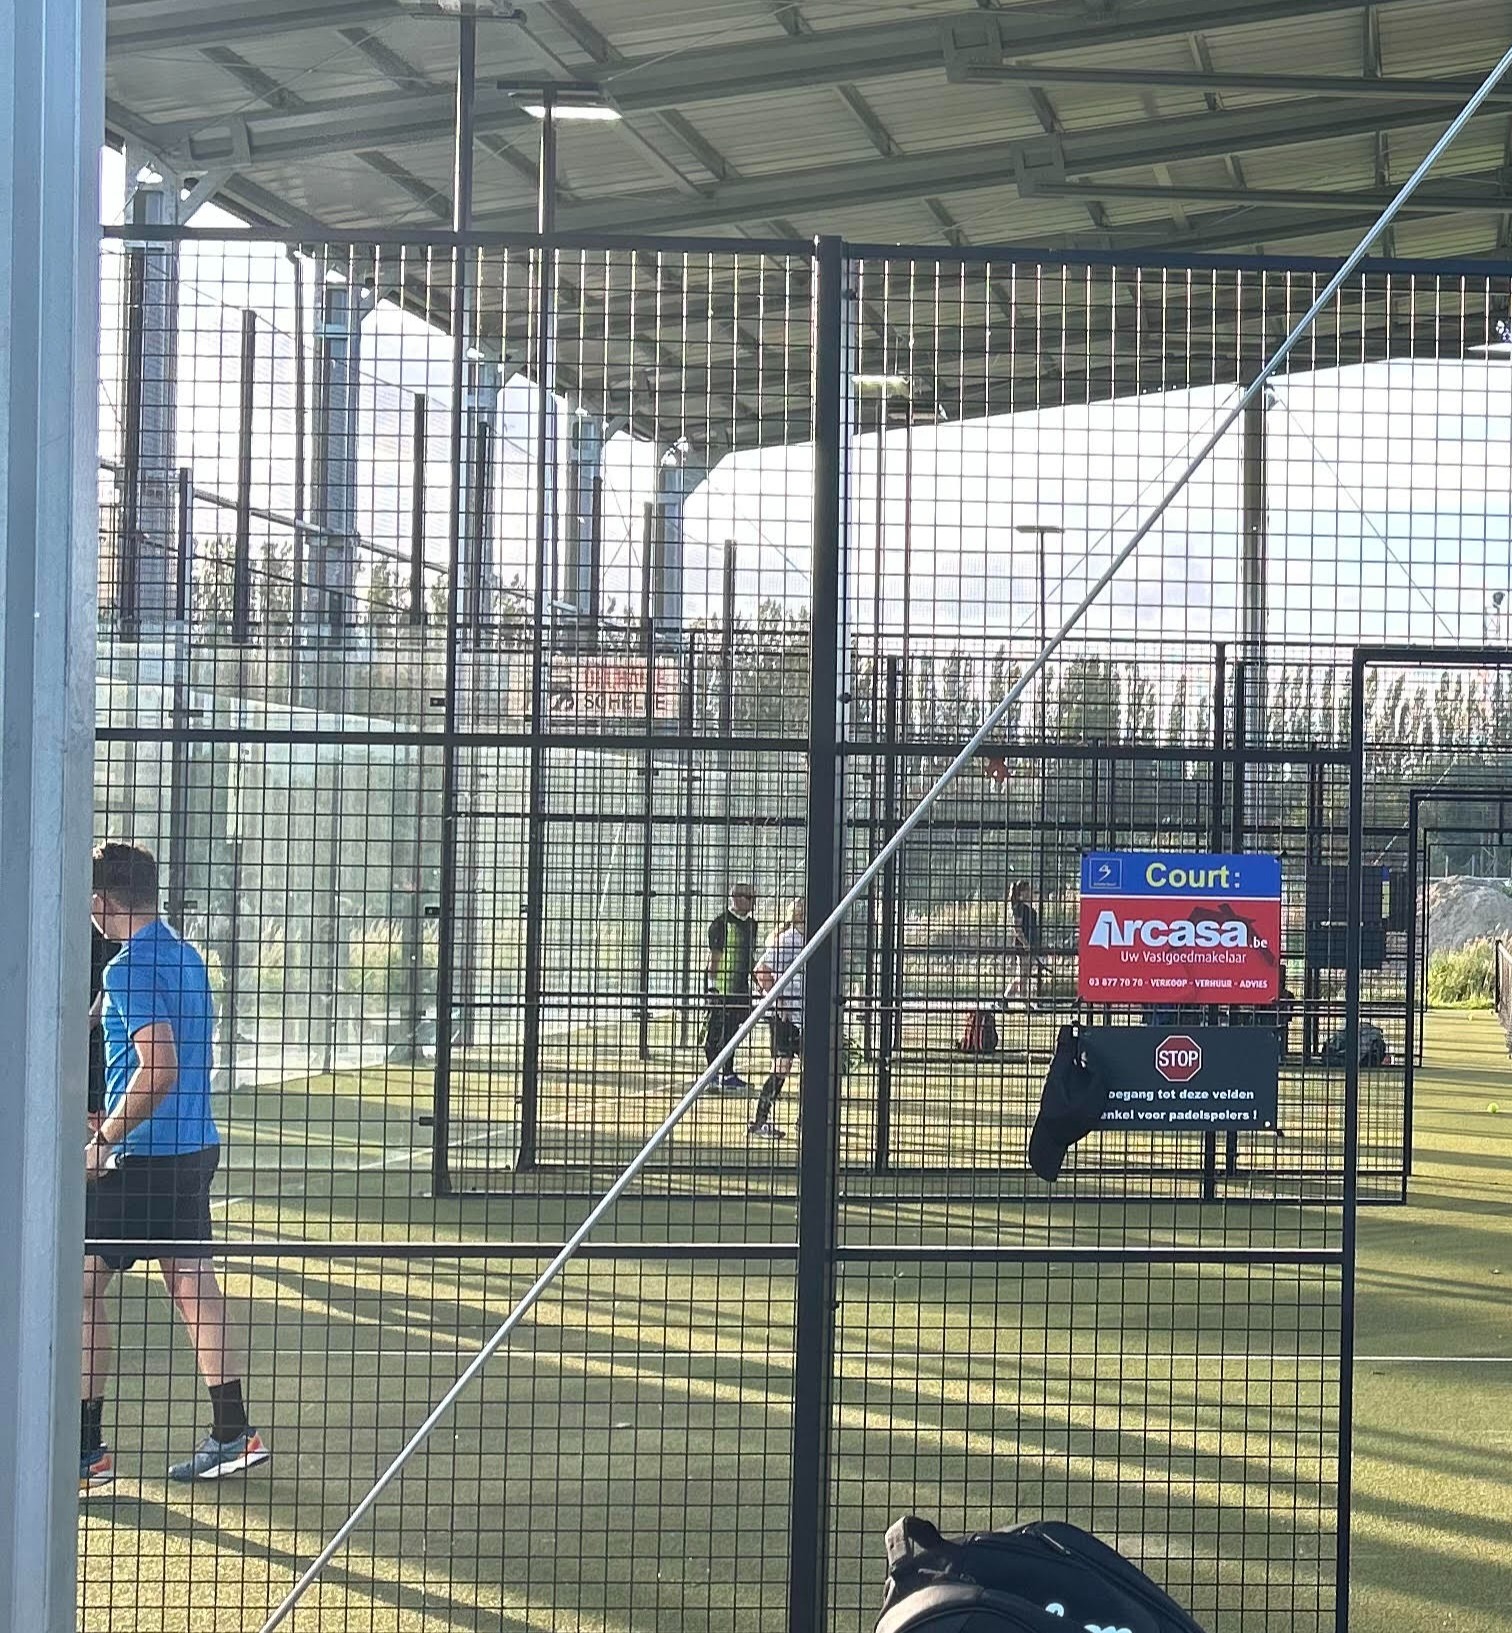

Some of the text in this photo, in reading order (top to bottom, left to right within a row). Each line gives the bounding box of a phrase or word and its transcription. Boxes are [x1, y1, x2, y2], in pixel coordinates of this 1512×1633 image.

[1145, 862, 1240, 888] Court:
[1120, 951, 1247, 966] Uw Vastgoedmakelaar
[1088, 977, 1100, 987] 03
[1150, 978, 1188, 988] VERKOOP
[1194, 979, 1233, 988] VERHUUR
[1239, 980, 1268, 989] ADVIES
[1158, 1050, 1199, 1067] STOP
[1108, 1089, 1254, 1102] oegang tot deze velden
[1137, 1111, 1167, 1120] voor
[1168, 1109, 1250, 1122] padelspelers
